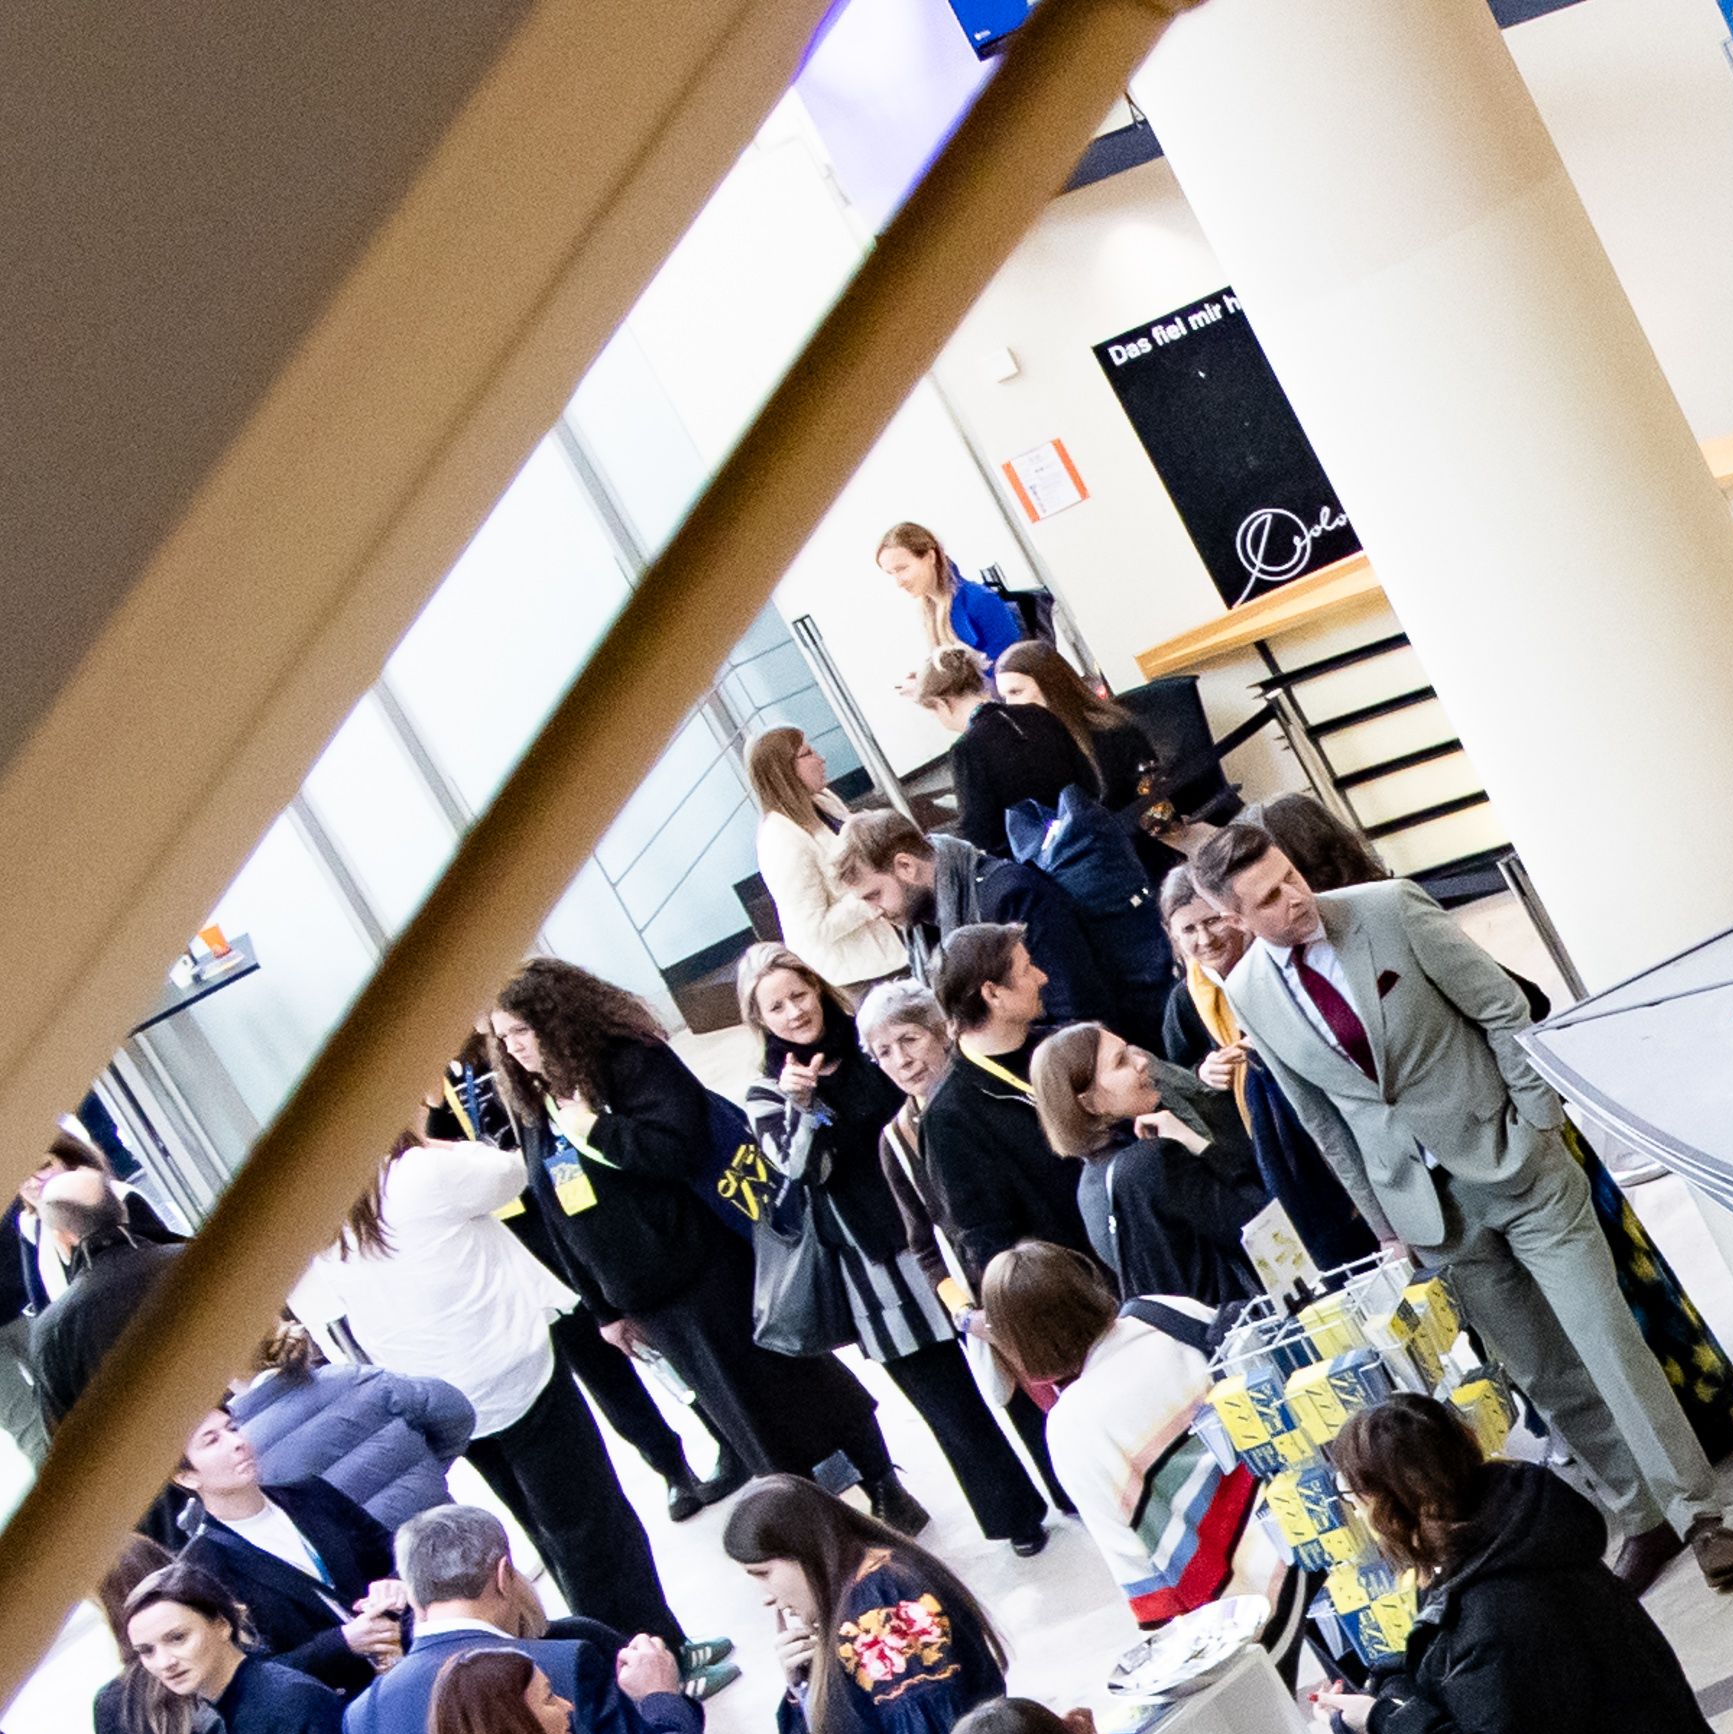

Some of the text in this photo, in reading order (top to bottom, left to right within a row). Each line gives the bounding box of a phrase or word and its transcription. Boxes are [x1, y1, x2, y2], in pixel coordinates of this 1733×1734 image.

[1107, 335, 1153, 367] Das
[1151, 316, 1188, 347] fiel
[1188, 302, 1223, 332] mir
